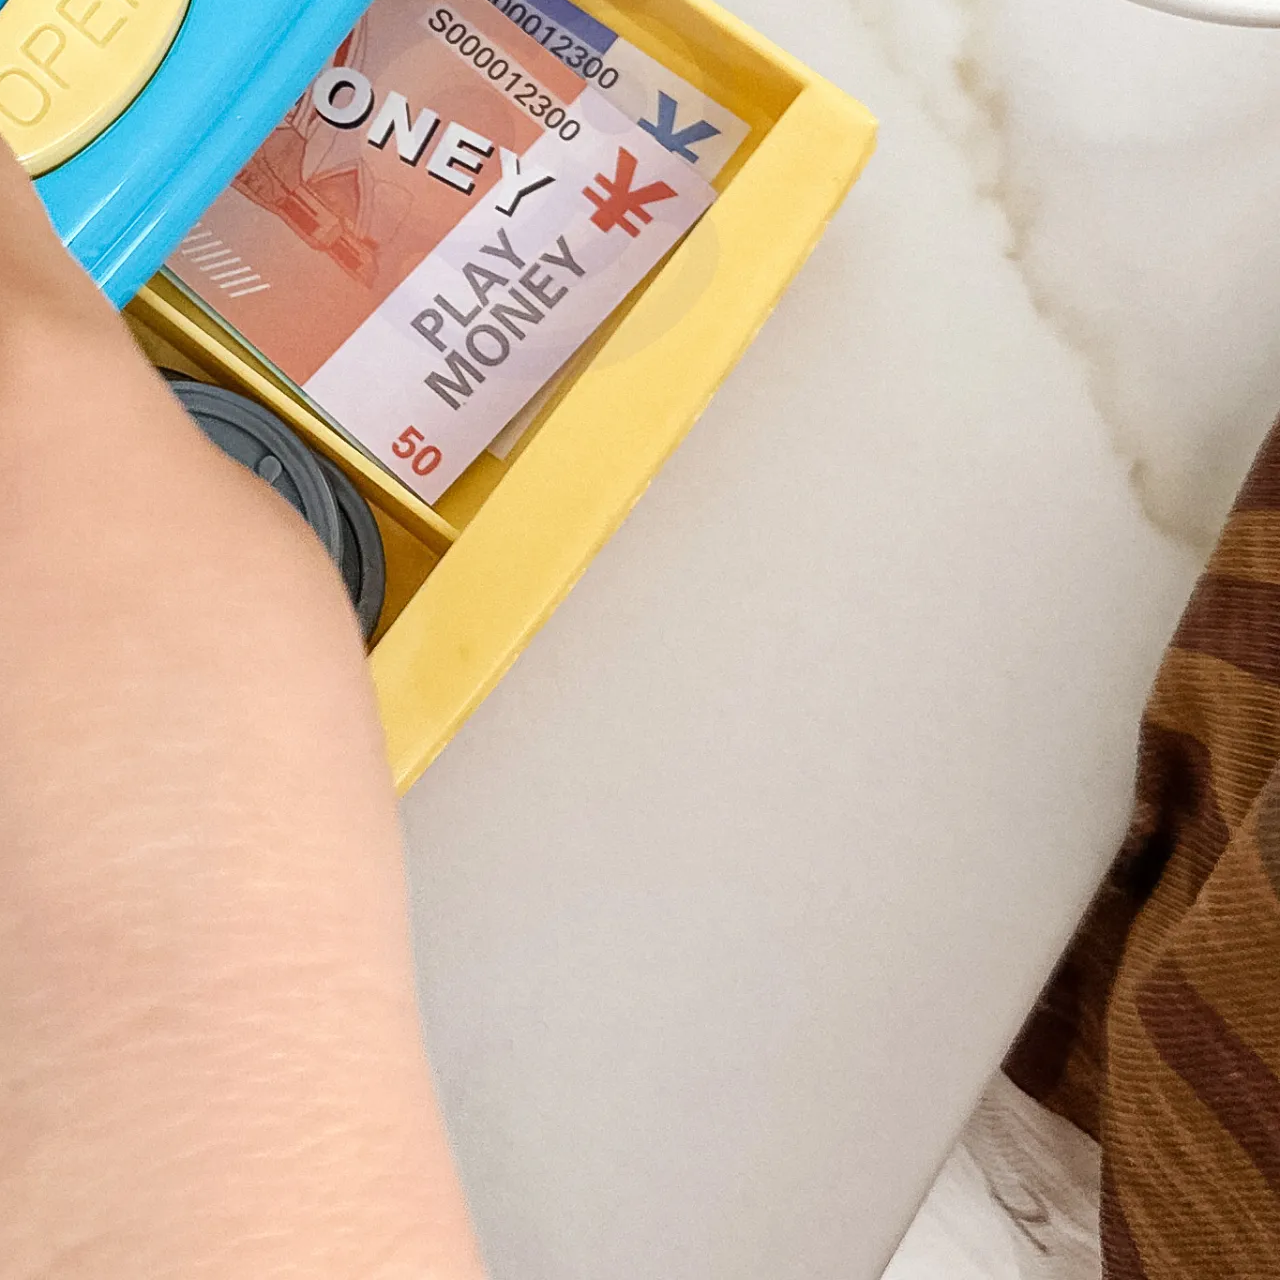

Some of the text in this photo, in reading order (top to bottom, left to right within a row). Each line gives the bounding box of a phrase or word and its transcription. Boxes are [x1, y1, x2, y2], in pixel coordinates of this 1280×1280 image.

[428, 8, 581, 141] S000012300
[313, 66, 556, 217] ONEY
[410, 228, 526, 352] PLAY
[424, 235, 586, 411] MONEY
[392, 425, 442, 476] 50
